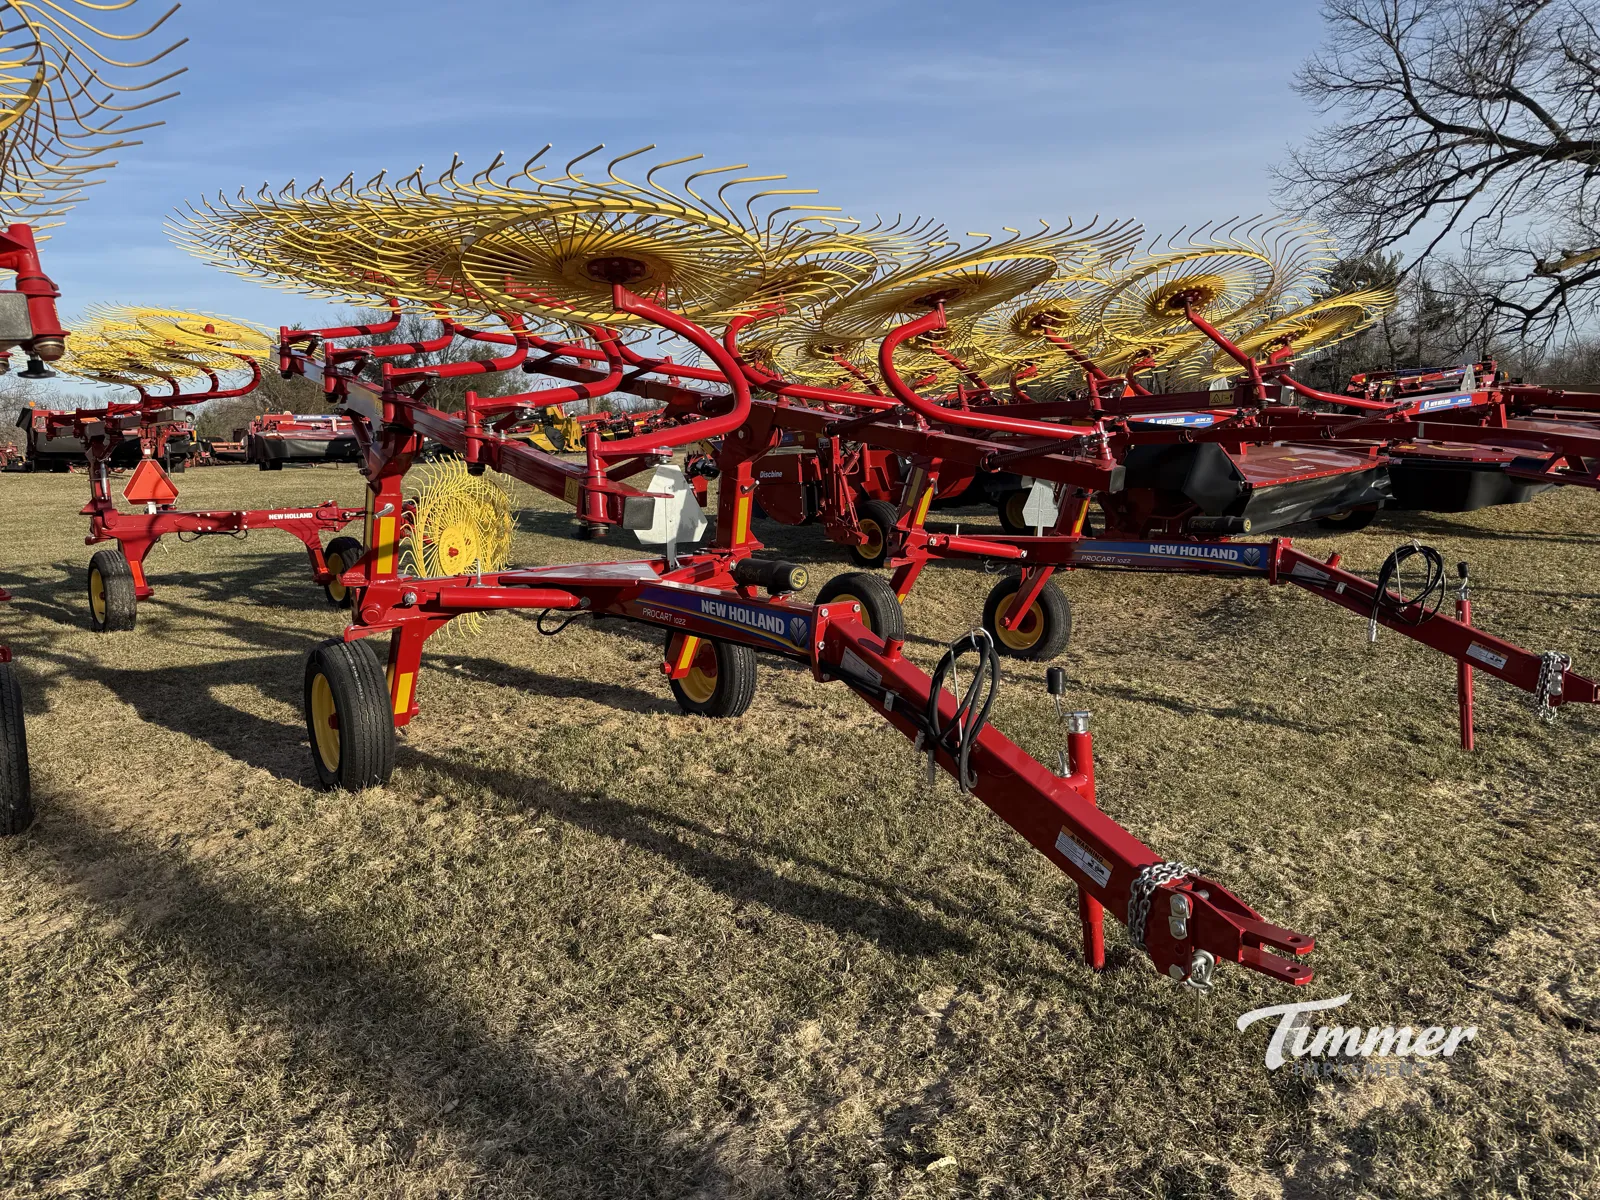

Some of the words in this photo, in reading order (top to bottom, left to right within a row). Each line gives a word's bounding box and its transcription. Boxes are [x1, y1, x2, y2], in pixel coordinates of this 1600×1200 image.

[760, 470, 783, 478] Discbine
[284, 512, 313, 520] HOLLAND
[1080, 555, 1116, 563] PROCART
[1150, 544, 1177, 555] NEW
[1179, 546, 1238, 561] HOLLAND
[642, 607, 673, 622] PROCART
[701, 599, 726, 618] NEW
[729, 605, 785, 635] HOLLAND
[1076, 837, 1104, 863] WARNING
